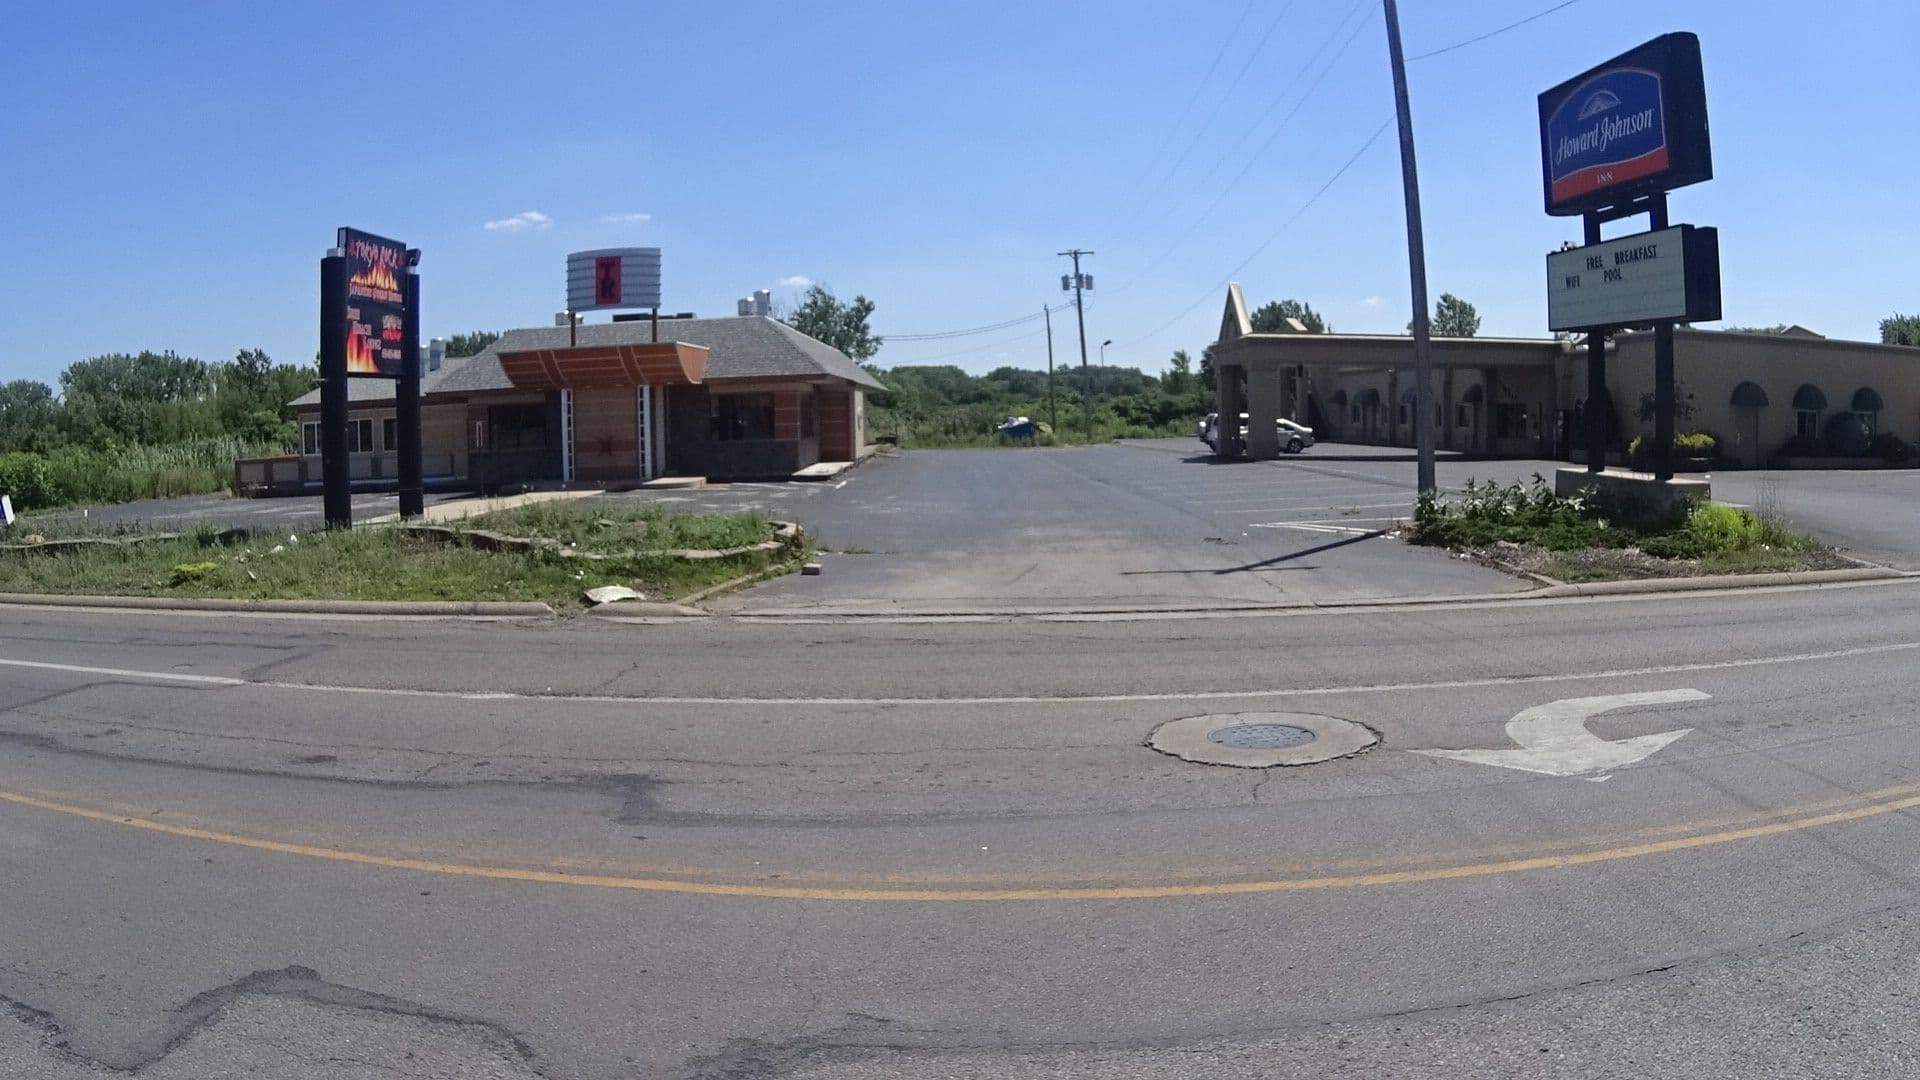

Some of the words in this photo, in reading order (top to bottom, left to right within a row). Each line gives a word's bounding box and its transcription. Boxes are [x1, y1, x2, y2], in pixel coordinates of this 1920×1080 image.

[1556, 123, 1599, 165] Howard
[1600, 108, 1652, 152] Johnson
[1597, 172, 1613, 184] INN
[1586, 256, 1603, 271] FREE
[1614, 245, 1657, 266] BREAKFAST
[1565, 275, 1580, 289] WIFI
[1603, 269, 1622, 283] POOL
